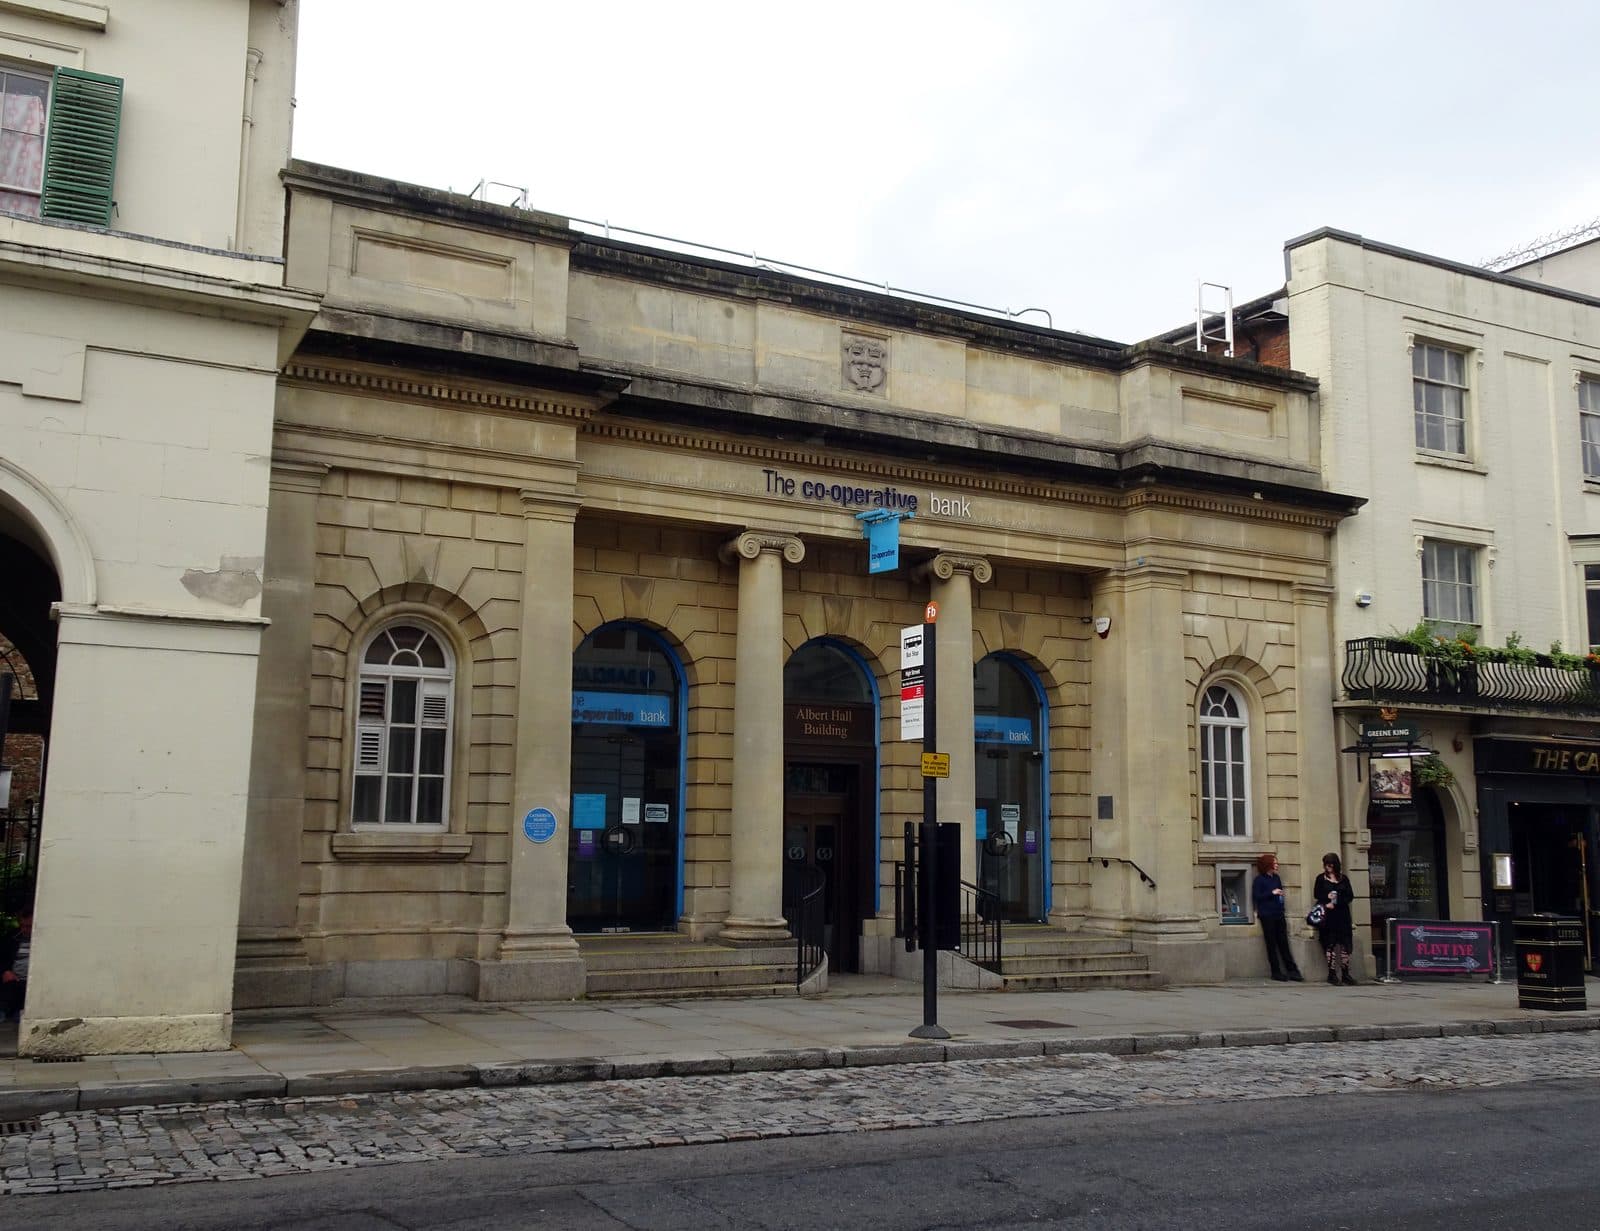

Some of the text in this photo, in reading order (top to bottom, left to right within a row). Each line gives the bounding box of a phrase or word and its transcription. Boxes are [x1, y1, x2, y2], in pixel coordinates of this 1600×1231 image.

[762, 469, 972, 518] The co-operative bank
[927, 606, 936, 619] Fb
[640, 709, 666, 723] bank
[796, 708, 853, 721] Albert Hall
[804, 722, 848, 739] Building
[1009, 728, 1030, 742] bank
[1367, 728, 1410, 738] GREENE KING
[1533, 749, 1570, 771] THE
[1557, 928, 1581, 938] LITTER
